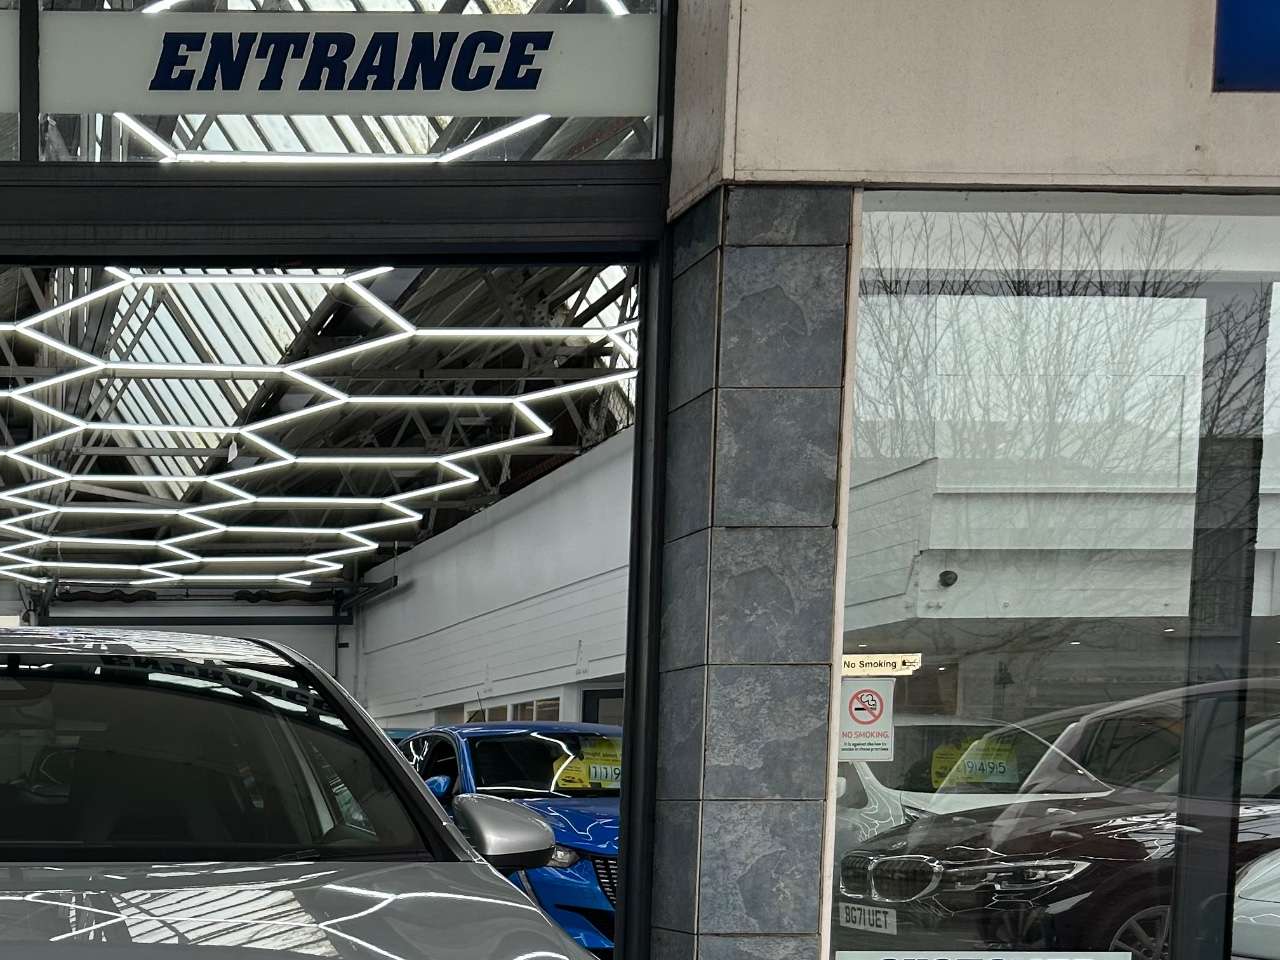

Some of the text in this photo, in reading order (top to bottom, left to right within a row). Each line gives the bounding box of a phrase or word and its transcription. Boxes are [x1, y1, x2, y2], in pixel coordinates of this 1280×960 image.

[148, 30, 555, 92] ENTRANCE
[843, 659, 897, 669] No Smoking
[841, 731, 889, 739] NO SMOKING
